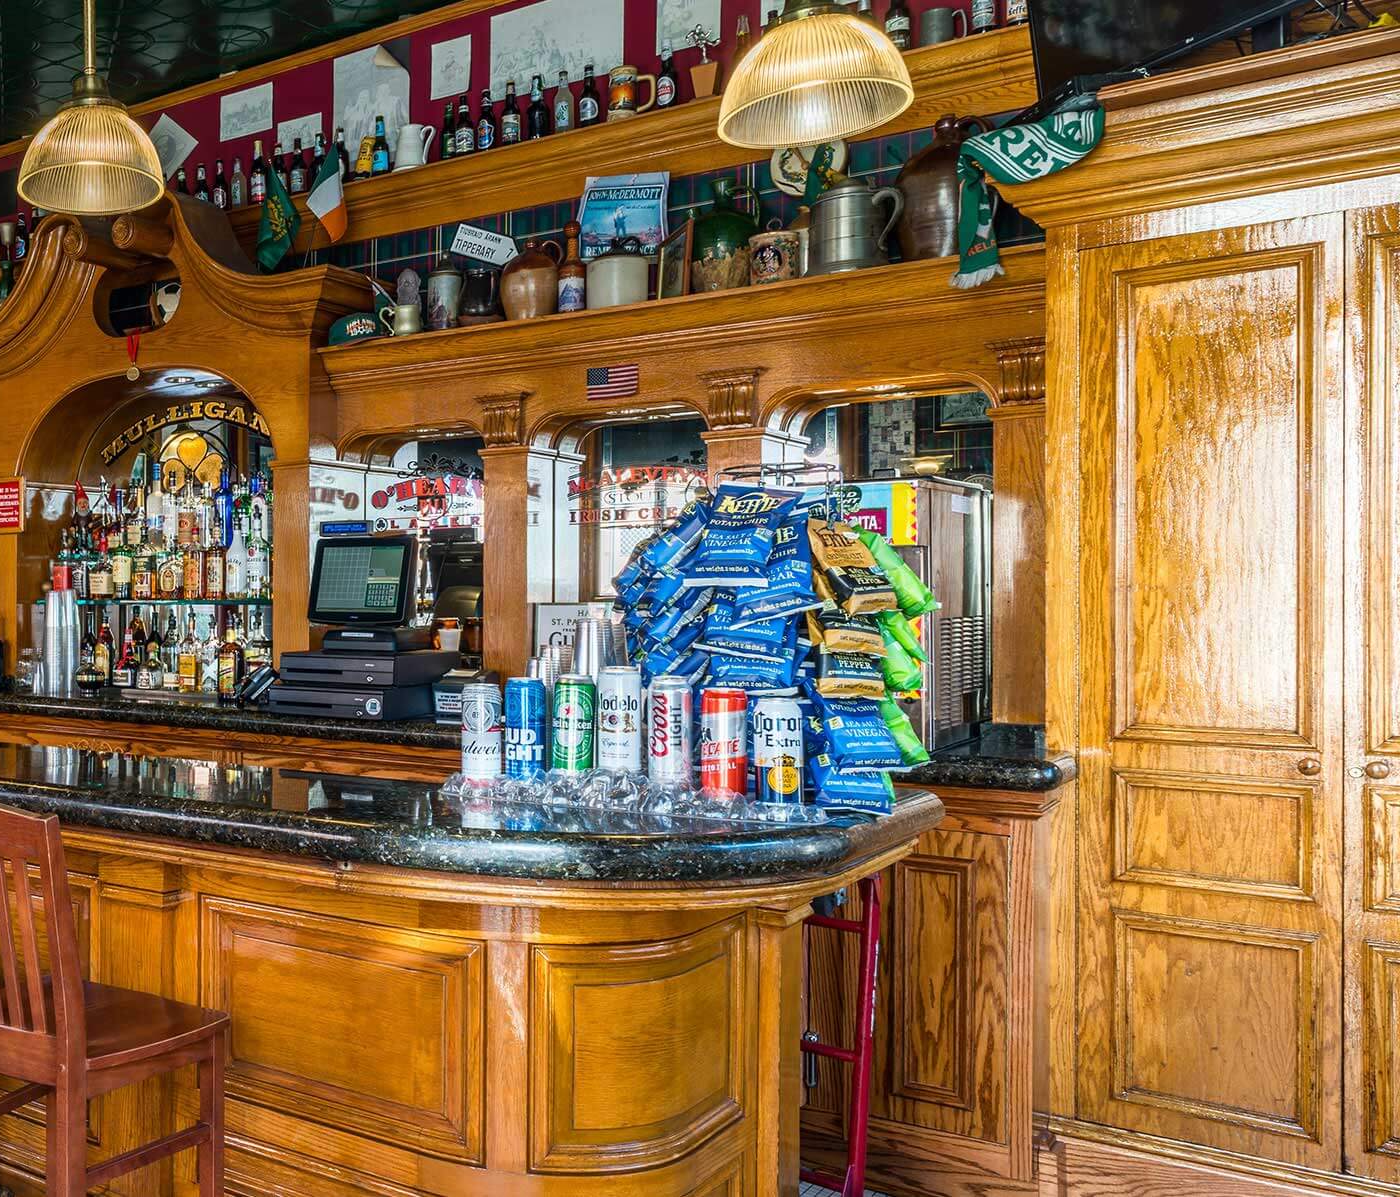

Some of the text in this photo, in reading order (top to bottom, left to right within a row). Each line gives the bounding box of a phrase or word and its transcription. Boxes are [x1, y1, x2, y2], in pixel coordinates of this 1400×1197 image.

[455, 238, 514, 259] TIPPERARY 7
[608, 490, 666, 504] STOUT
[569, 510, 627, 523] IRISH
[710, 518, 743, 527] POTATO
[704, 538, 752, 548] VINEGAR
[770, 548, 797, 560] CHIPS
[839, 660, 872, 670] PEPPER
[649, 693, 668, 758] Coors
[671, 705, 682, 746] LIGHT
[505, 728, 536, 745] UD
[505, 744, 544, 761] GHT
[701, 738, 740, 757] ECATE
